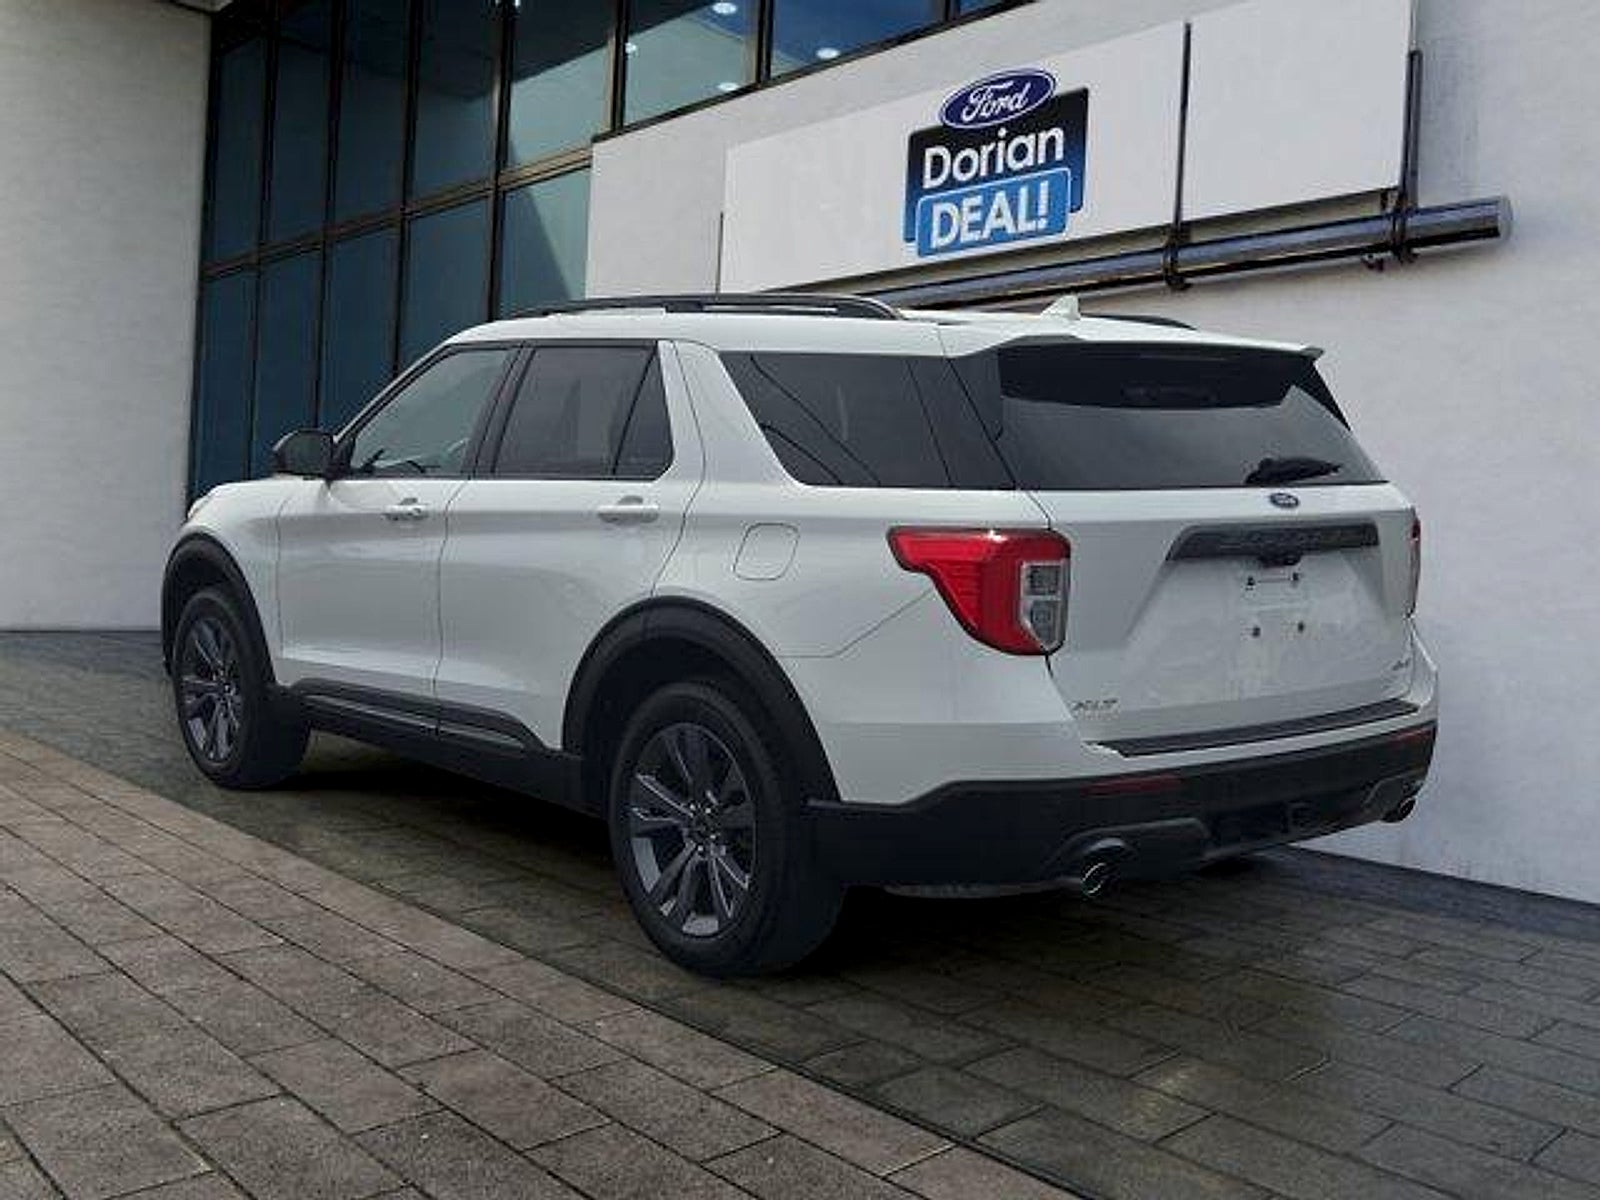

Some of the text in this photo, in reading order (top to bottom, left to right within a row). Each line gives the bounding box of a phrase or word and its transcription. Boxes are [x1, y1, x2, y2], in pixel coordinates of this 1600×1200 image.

[962, 81, 1031, 122] Ford
[922, 127, 1064, 189] Dorian
[930, 180, 1049, 248] DEAL!
